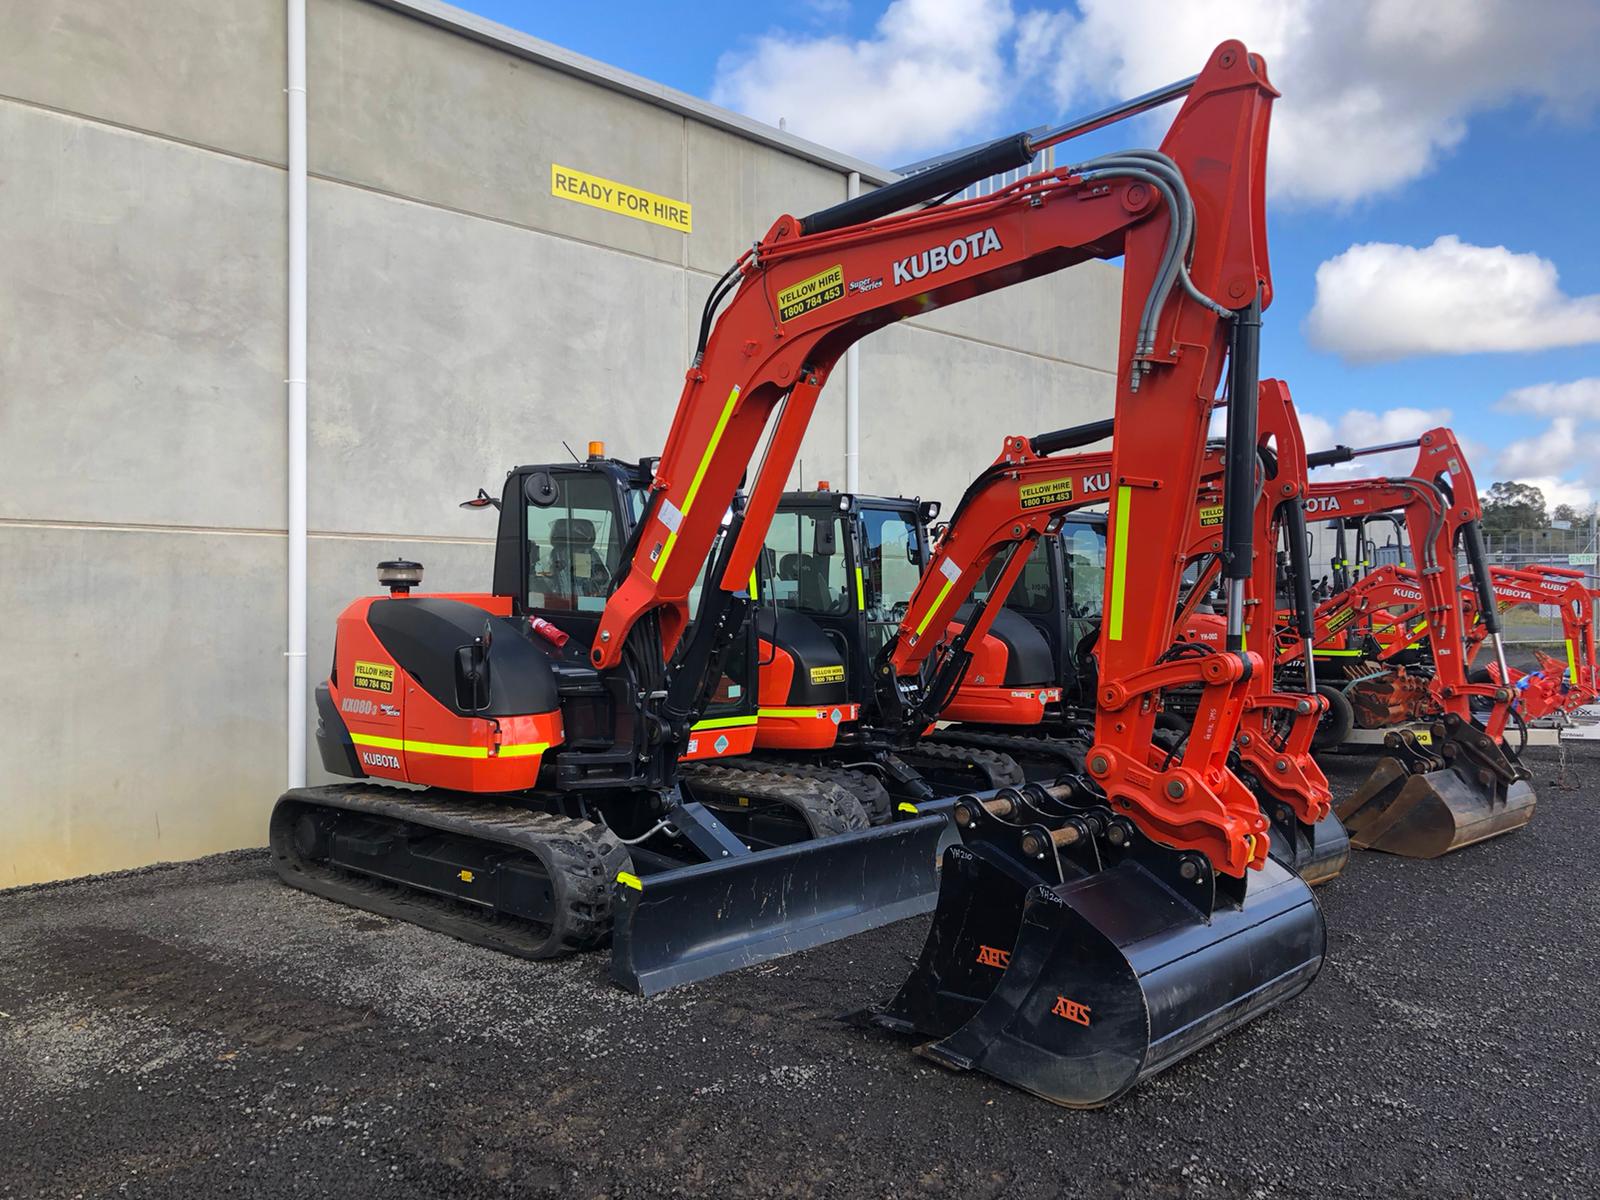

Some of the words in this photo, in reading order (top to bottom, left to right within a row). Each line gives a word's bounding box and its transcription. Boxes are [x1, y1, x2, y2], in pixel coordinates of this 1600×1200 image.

[555, 173, 613, 203] READY
[617, 191, 650, 215] FOR
[654, 201, 689, 226] HIRE
[892, 227, 1002, 286] KUBOTA
[780, 281, 816, 305] YELLOW
[818, 271, 841, 288] HIRE
[783, 302, 804, 319] 1800
[805, 295, 822, 309] 784
[823, 286, 841, 301] 453
[1021, 485, 1051, 497] YELLOW
[1052, 481, 1071, 490] HIRE
[1023, 498, 1041, 507] 1800
[1041, 495, 1055, 503] 784
[1056, 492, 1070, 501] 453
[1305, 496, 1341, 513] OTA
[1201, 509, 1223, 517] YELLO
[1393, 587, 1422, 600] KUBO
[1492, 586, 1532, 599] KUBOTA
[1540, 582, 1568, 592] KUBO
[356, 665, 378, 676] YELLOW
[379, 669, 393, 679] HIRE
[368, 679, 380, 690] 784
[380, 681, 392, 692] 453
[362, 752, 401, 769] KUBOTA
